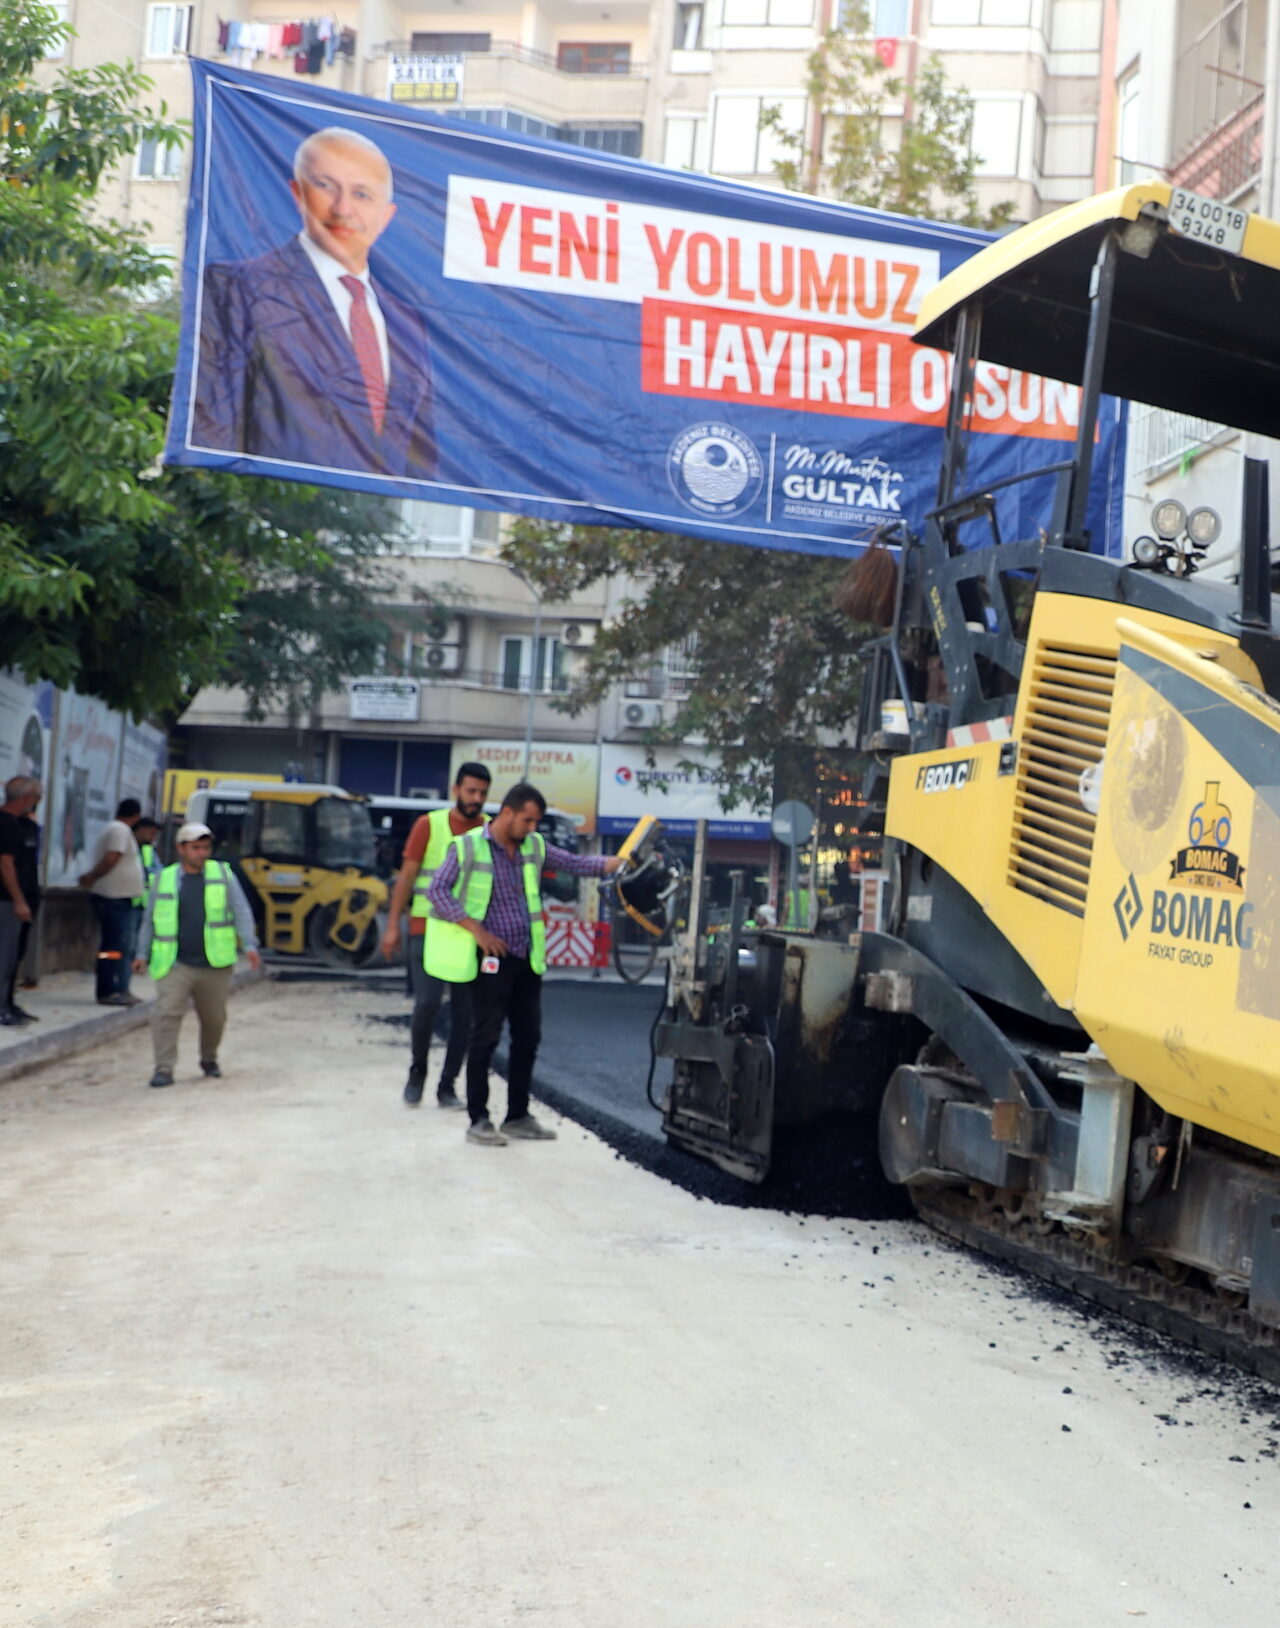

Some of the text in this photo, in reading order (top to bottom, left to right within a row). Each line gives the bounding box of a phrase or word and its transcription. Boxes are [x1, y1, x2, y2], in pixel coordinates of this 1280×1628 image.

[1175, 193, 1196, 213] 34
[1226, 211, 1244, 230] 18
[1182, 216, 1226, 244] 8348
[471, 196, 921, 325] YENİ YOLUMUZ
[664, 316, 1084, 427] HAYIRLI OSUN
[477, 748, 521, 762] SEDEF
[1185, 849, 1228, 872] BOMAG
[1151, 890, 1255, 951] BOMAG
[1148, 943, 1214, 969] FAYAT GROUP
